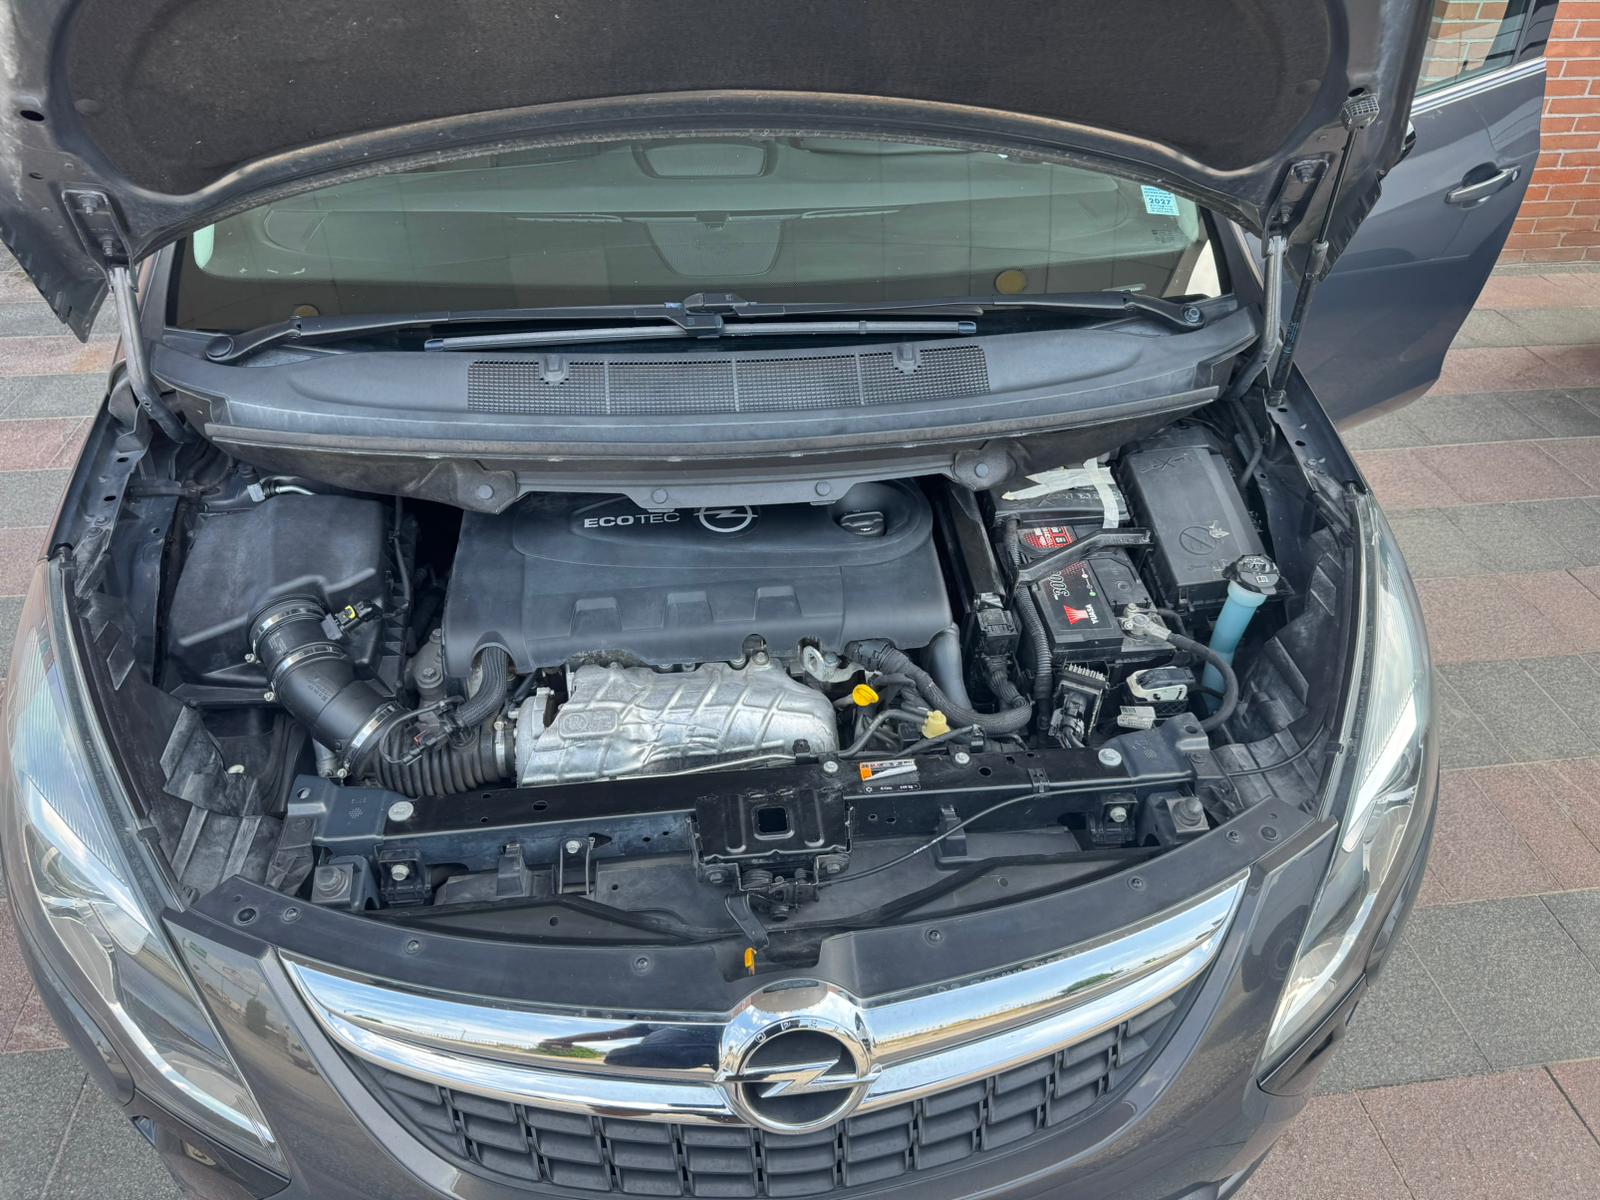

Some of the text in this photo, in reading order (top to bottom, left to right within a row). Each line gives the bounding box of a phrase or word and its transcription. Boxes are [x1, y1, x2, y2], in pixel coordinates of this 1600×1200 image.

[584, 512, 680, 528] ECOTEC
[1047, 571, 1070, 597] 300
[1085, 603, 1099, 625] YUASA
